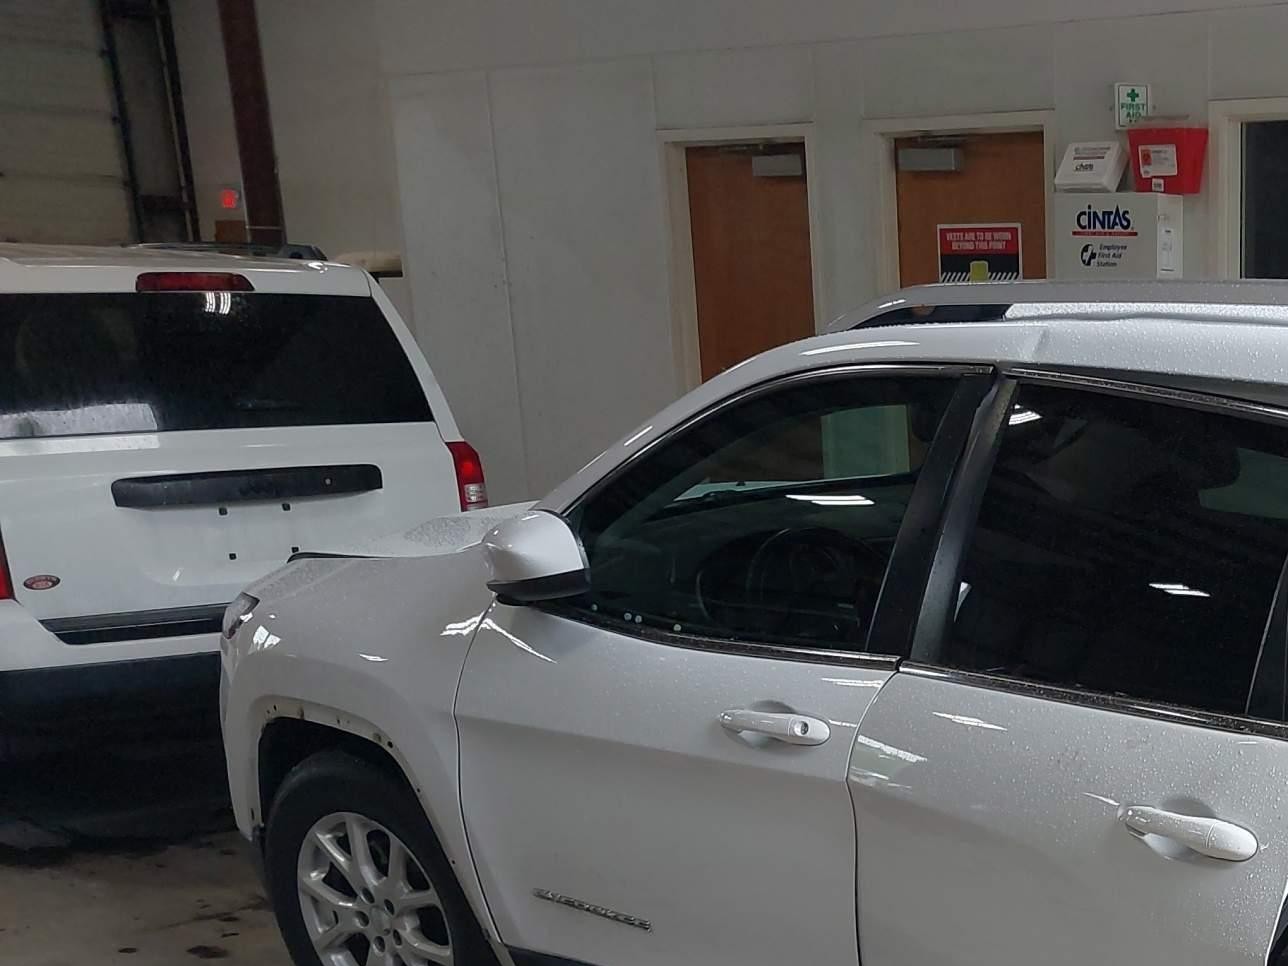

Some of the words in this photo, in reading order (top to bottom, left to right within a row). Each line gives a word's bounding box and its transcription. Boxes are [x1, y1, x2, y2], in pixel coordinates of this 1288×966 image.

[1121, 103, 1145, 111] FIRST
[1076, 204, 1132, 231] CINTAS
[1099, 244, 1128, 253] Employee
[1111, 252, 1123, 260] Aid
